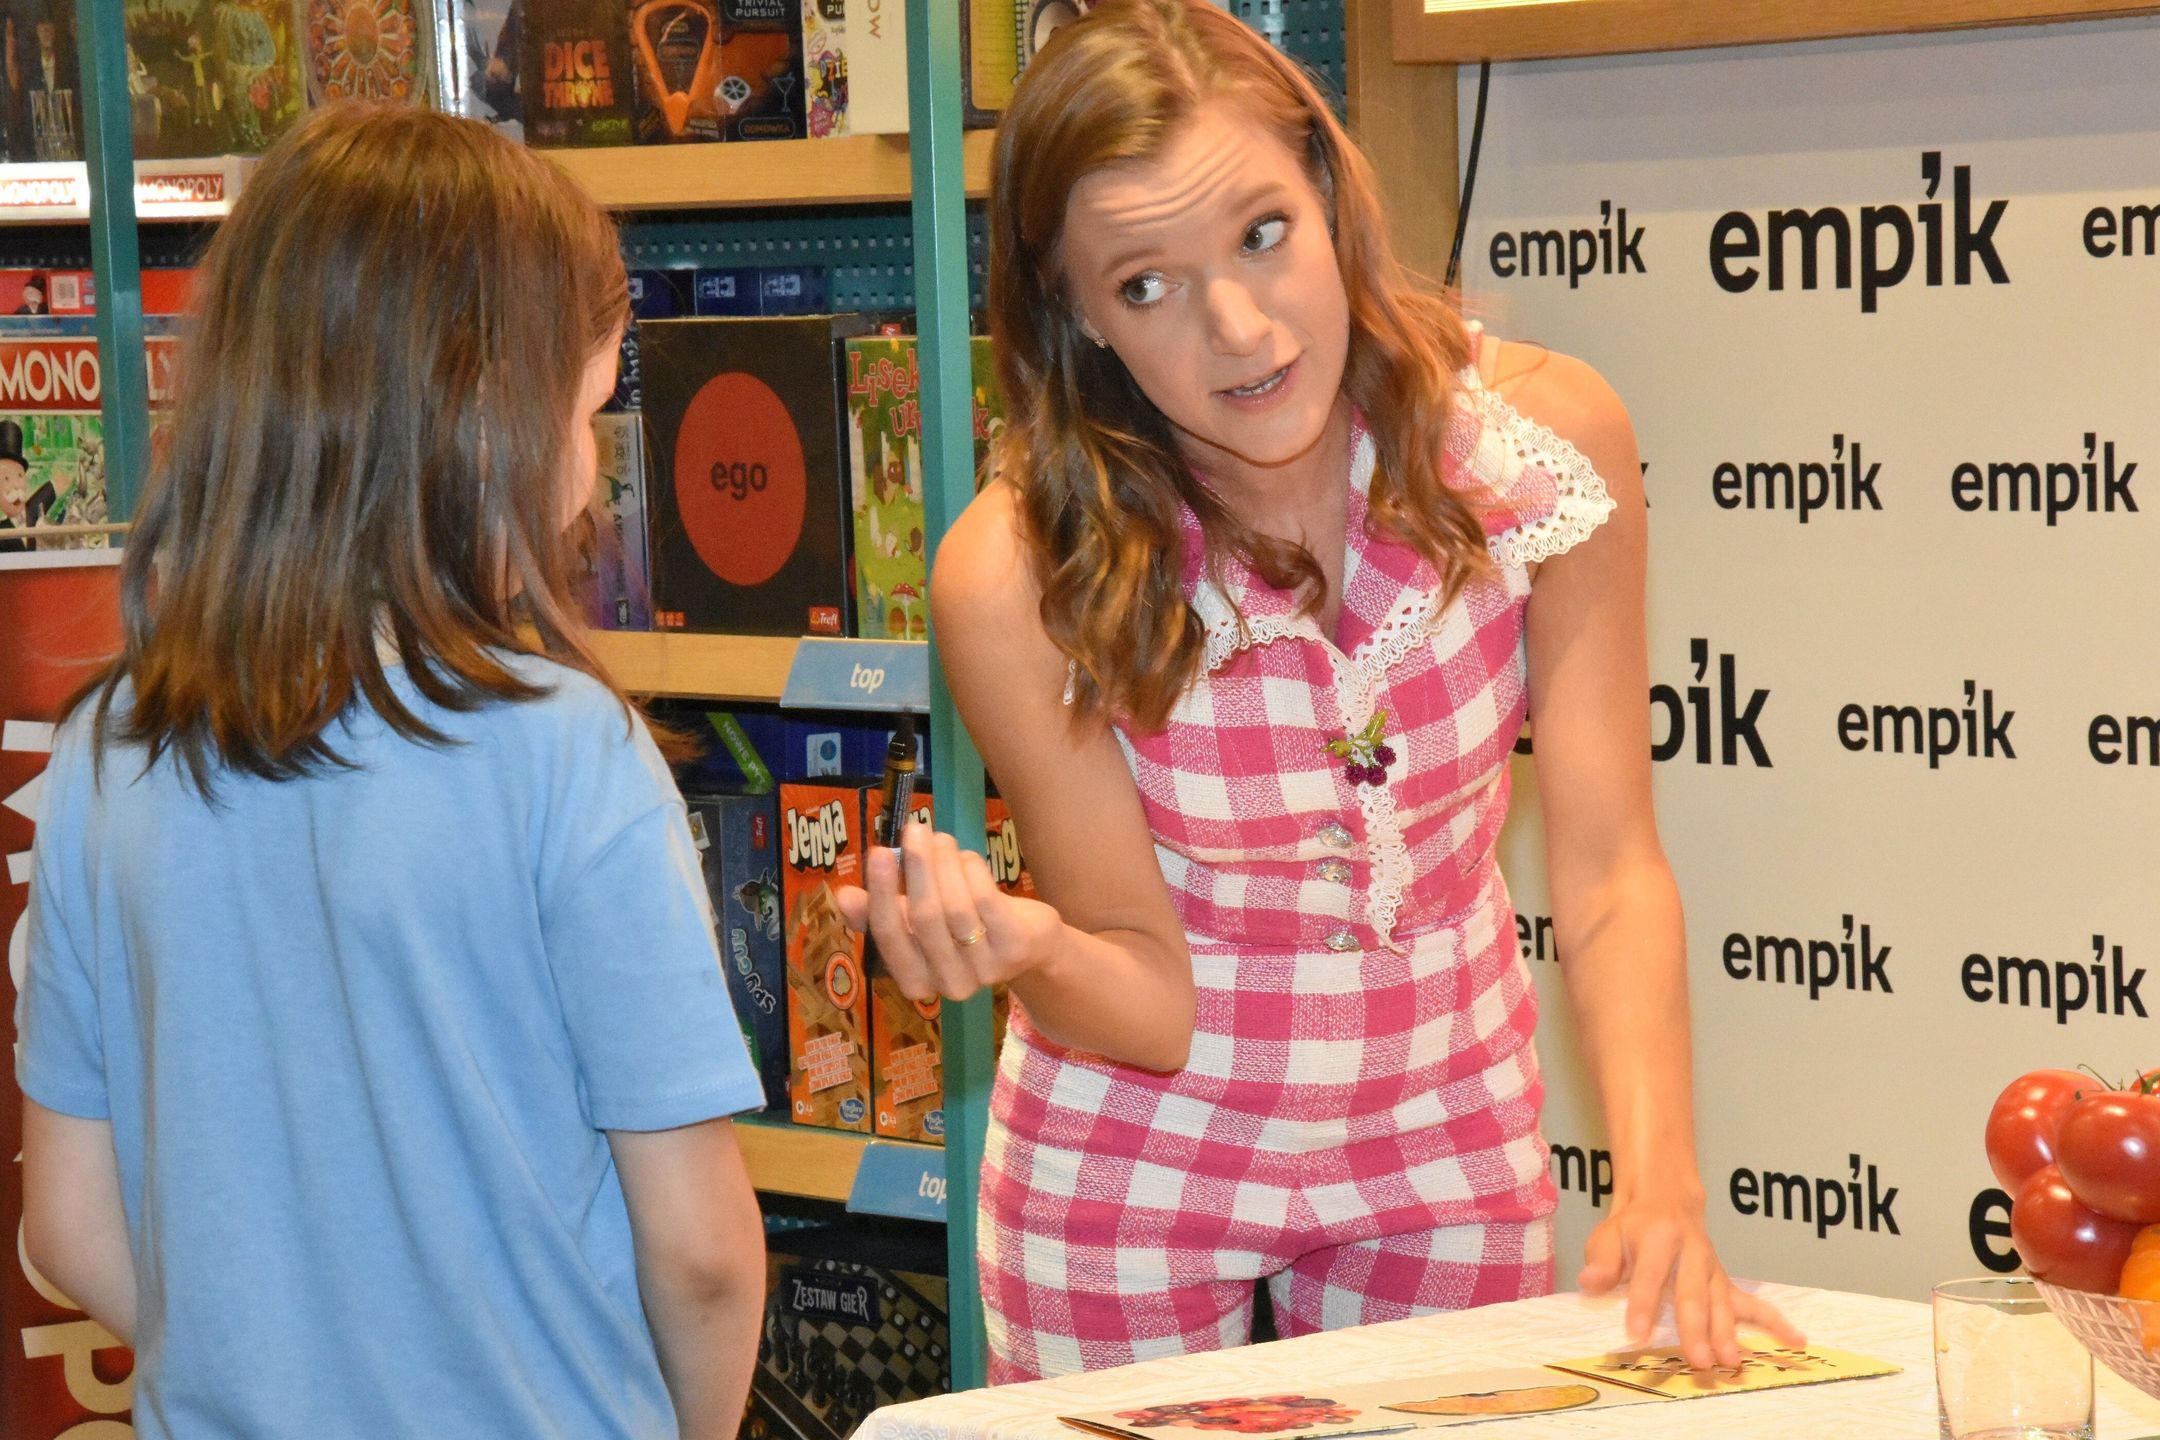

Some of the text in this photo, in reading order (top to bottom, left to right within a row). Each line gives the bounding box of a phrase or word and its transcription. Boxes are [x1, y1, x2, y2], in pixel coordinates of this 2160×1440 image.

[735, 8, 786, 17] PURSUIT
[543, 79, 614, 109] THRONE
[544, 41, 610, 80] DICE
[1489, 199, 1646, 289] empik
[1709, 151, 2010, 313] empik
[710, 458, 768, 500] ego
[1712, 434, 1883, 524] empik
[1951, 432, 2139, 527] empik
[850, 662, 885, 694] top
[1837, 679, 2016, 769] empik
[787, 799, 848, 868] Jenga
[1722, 914, 1893, 1001] empik
[1961, 934, 2148, 1025] empik
[1729, 1153, 1900, 1239] empik
[792, 1278, 870, 1321] ZESTAW GIER
